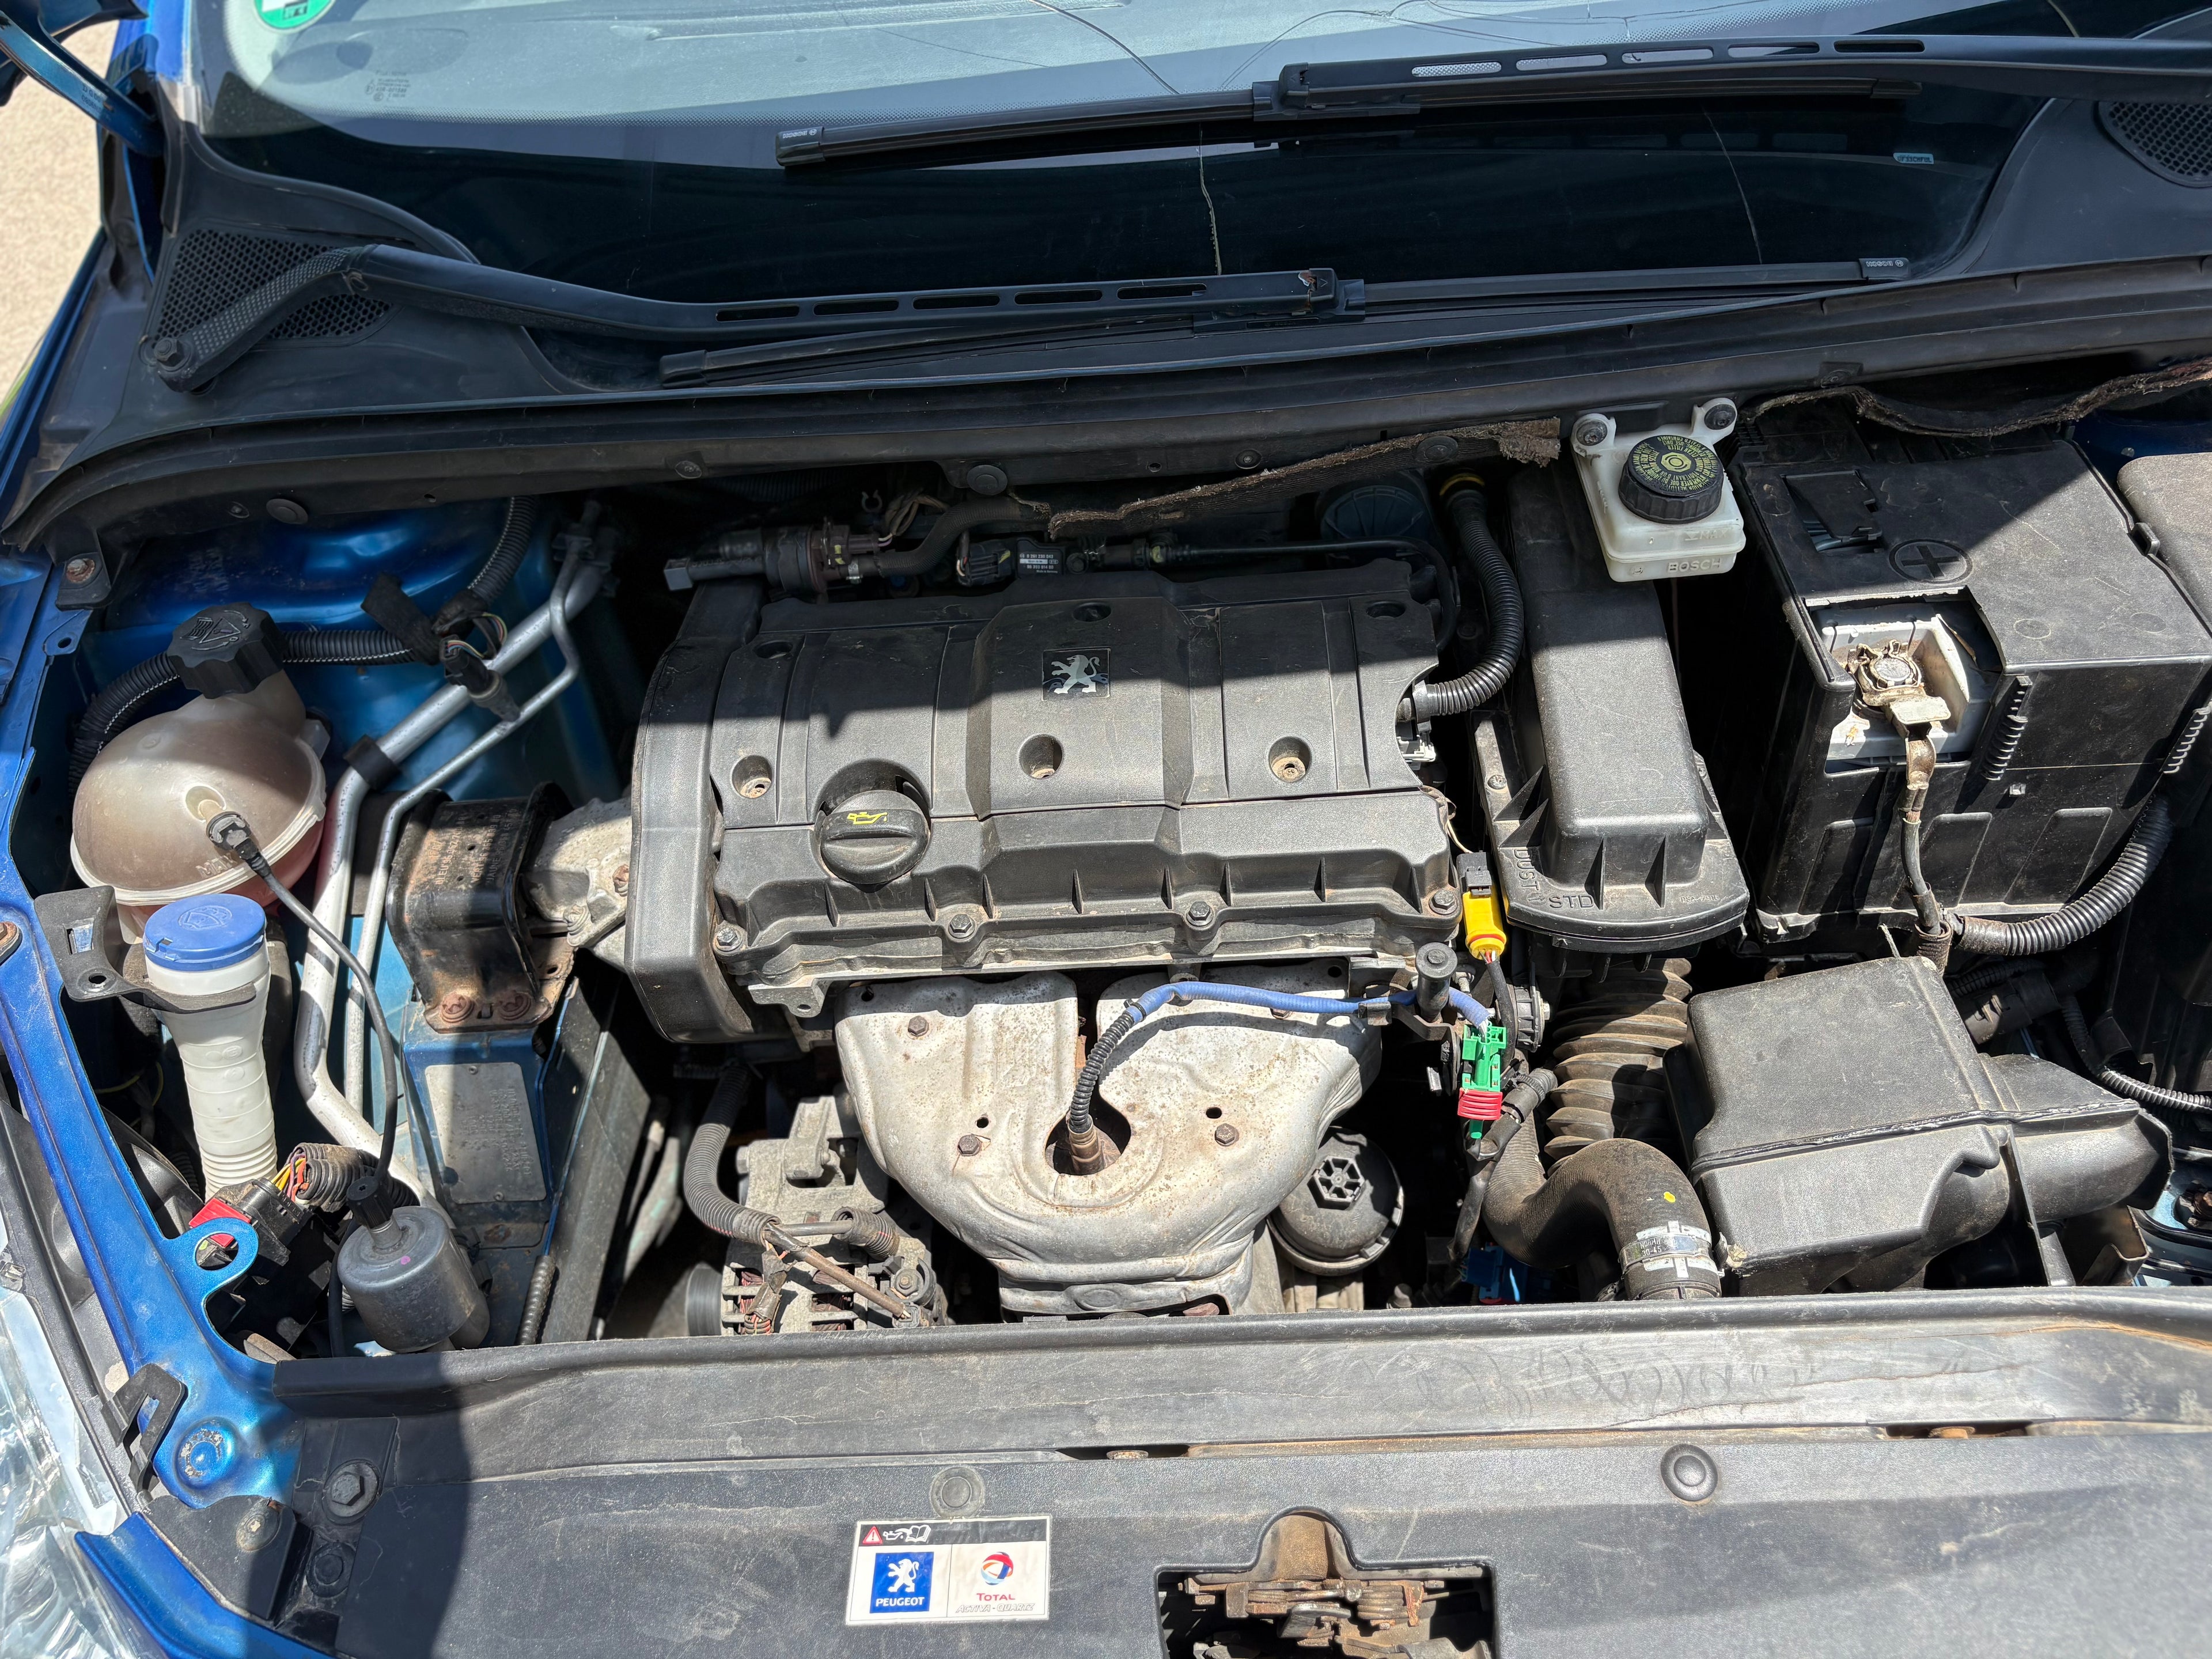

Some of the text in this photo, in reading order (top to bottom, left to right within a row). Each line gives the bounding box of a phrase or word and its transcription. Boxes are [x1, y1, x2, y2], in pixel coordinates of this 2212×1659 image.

[1666, 556, 1722, 573] BOSCH
[1512, 848, 1541, 891] DUST
[1548, 893, 1596, 909] STD
[1639, 1237, 1661, 1249] NORMA
[1641, 1247, 1662, 1257] 30-45
[875, 1596, 925, 1607] PEUGEOT
[995, 1602, 1036, 1613] QUARTZ
